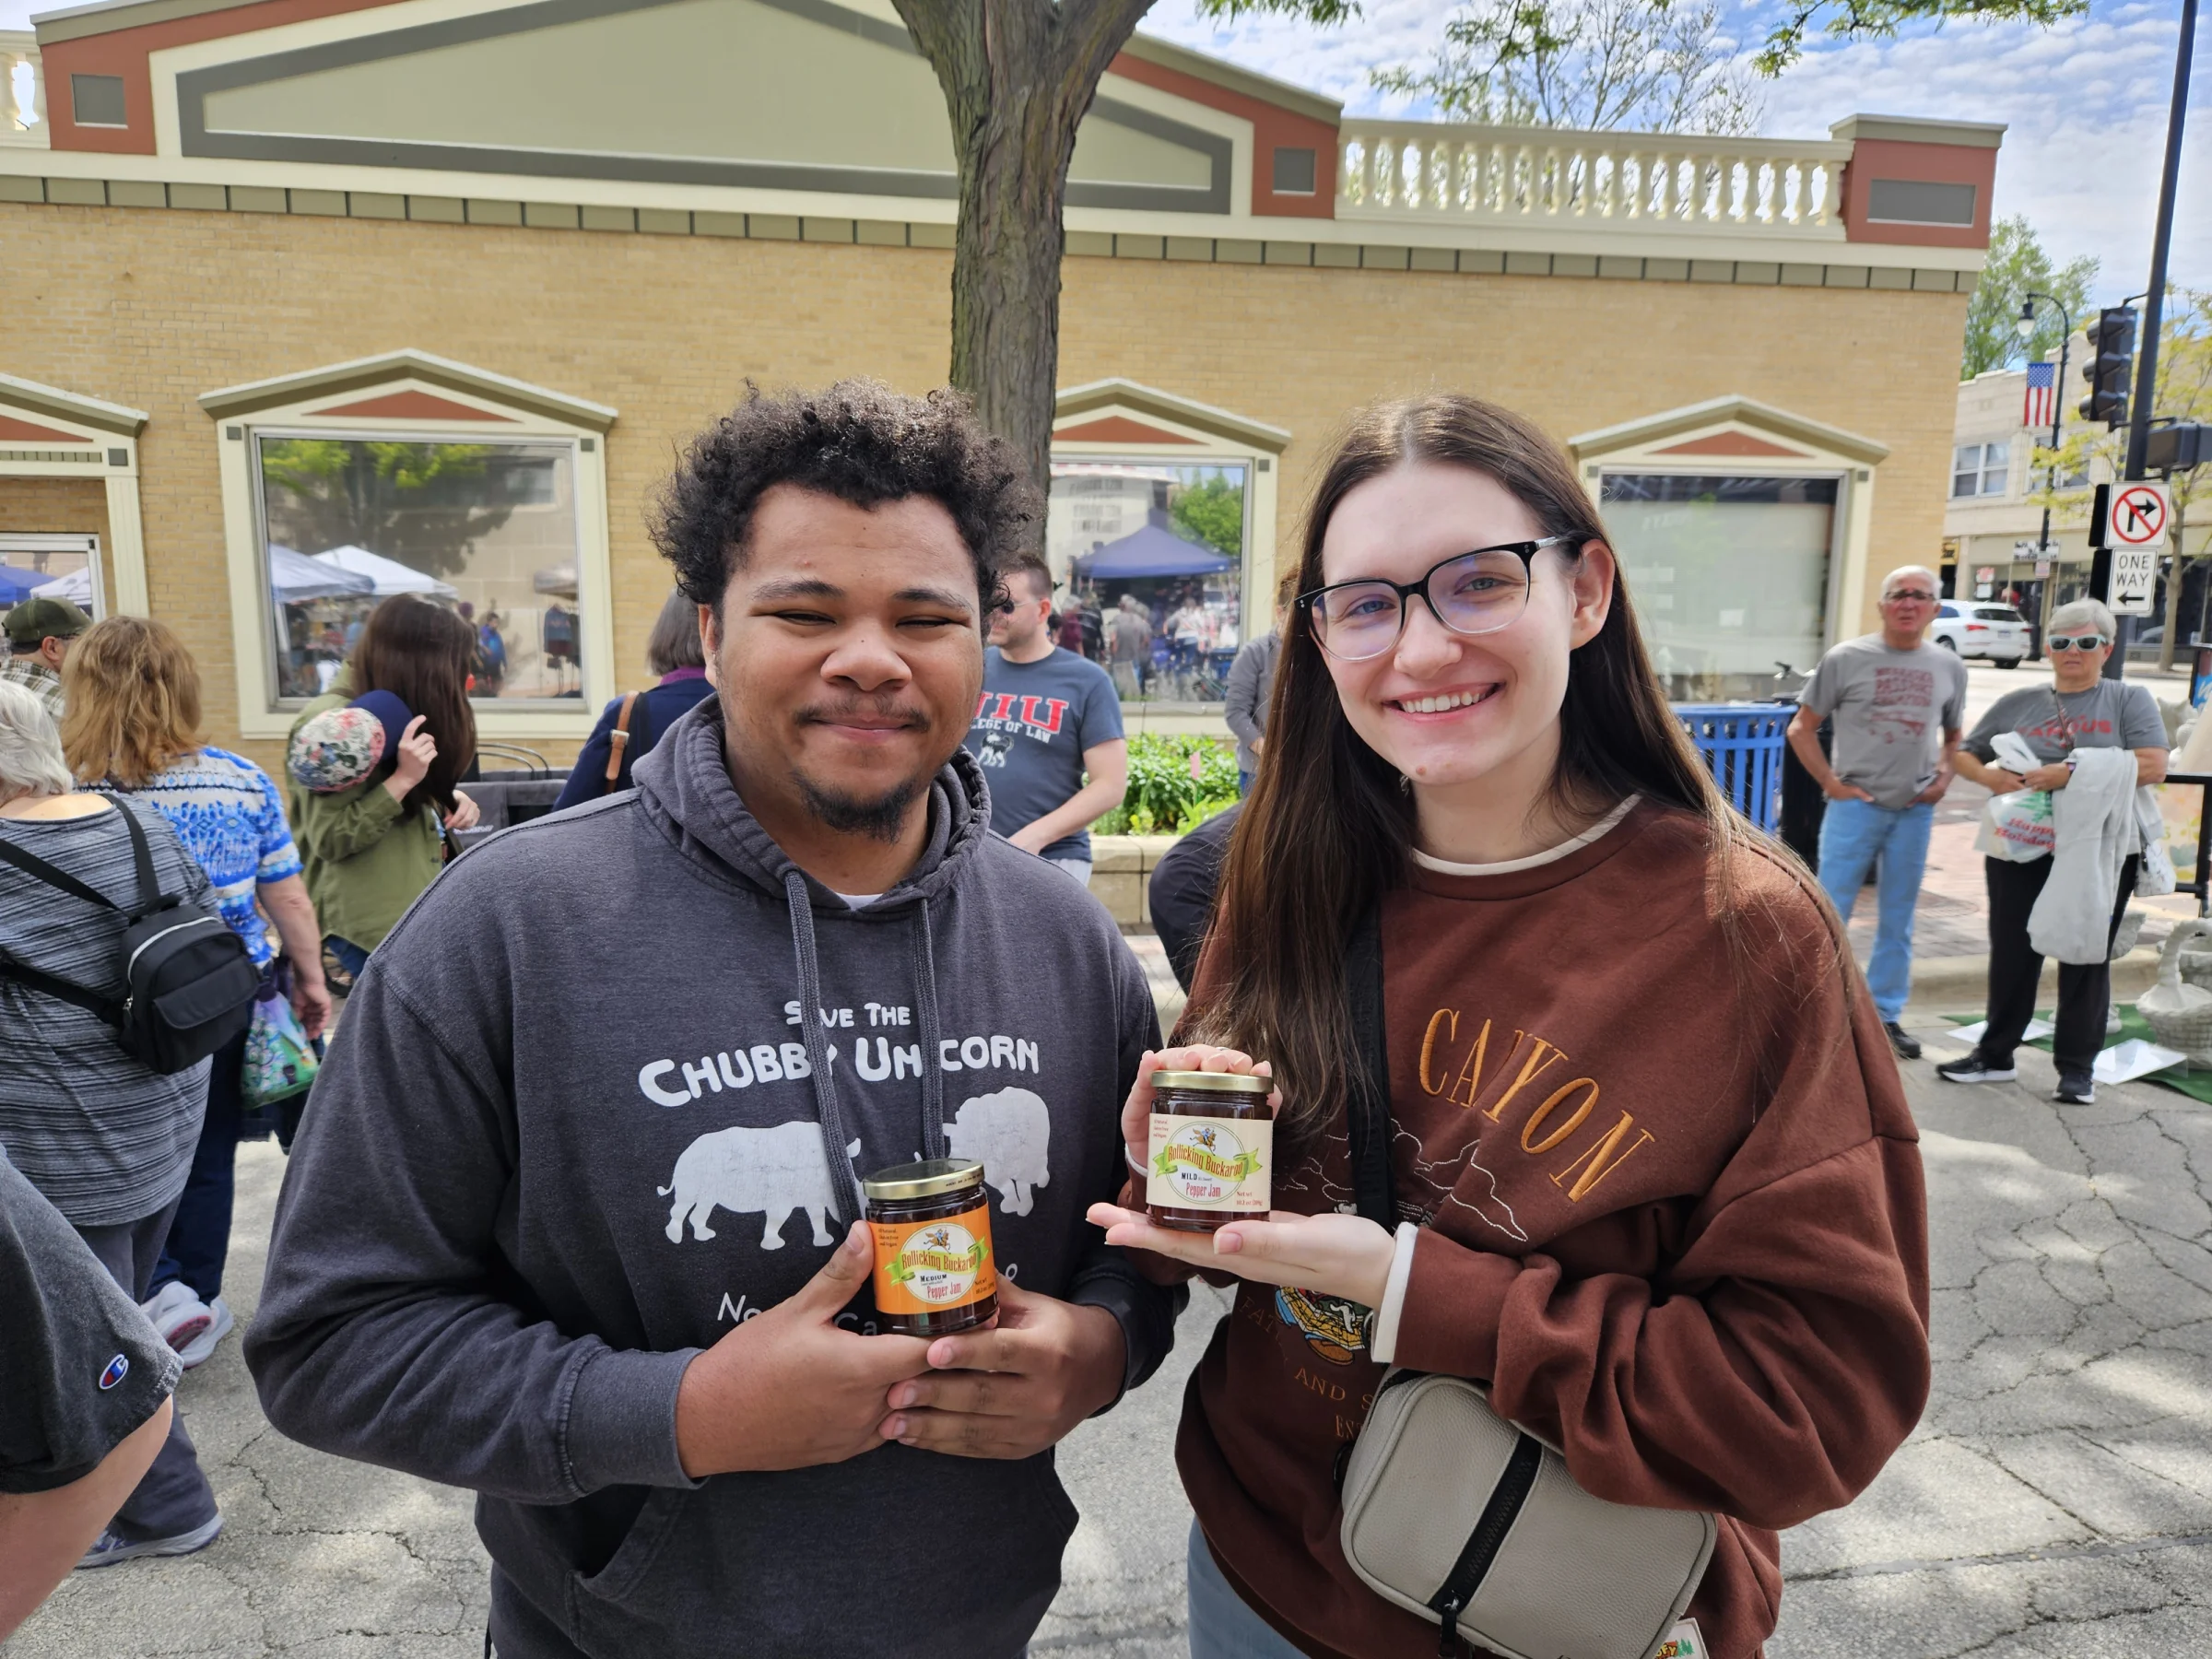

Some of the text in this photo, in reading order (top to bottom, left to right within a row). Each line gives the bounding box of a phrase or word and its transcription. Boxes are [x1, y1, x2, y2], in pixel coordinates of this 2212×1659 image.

[2119, 554, 2150, 570] ONE
[2116, 571, 2148, 587] WAY
[970, 717, 1052, 744] LEGE OF LAW
[1994, 826, 2055, 850] Holiday
[784, 1000, 854, 1029] SVE
[855, 1035, 1039, 1082] UNCORN
[1419, 1007, 1655, 1203] CAYON
[1168, 1144, 1243, 1178] Rollicking Buckaroo
[1181, 1172, 1198, 1181] MILD
[1186, 1182, 1221, 1198] Pepper Jam
[901, 1251, 977, 1272] Rollicking Buckaroo
[927, 1285, 947, 1300] Pepper
[950, 1282, 962, 1295] Jam
[1293, 1367, 1346, 1401] AND
